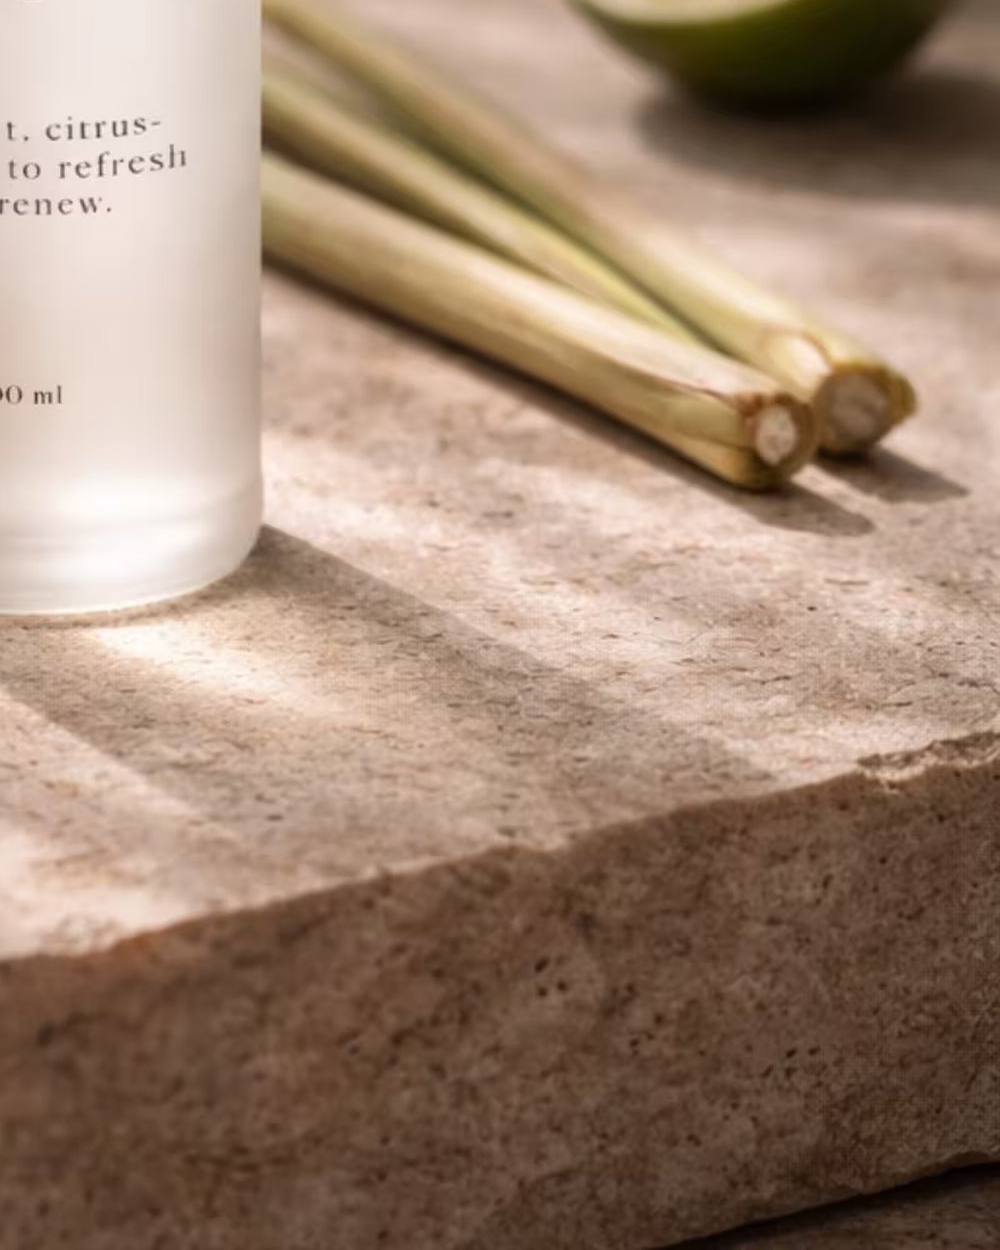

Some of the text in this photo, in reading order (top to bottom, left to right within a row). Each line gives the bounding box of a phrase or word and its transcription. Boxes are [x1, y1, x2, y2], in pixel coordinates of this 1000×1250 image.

[45, 116, 163, 142] citrus-
[8, 160, 42, 180] to
[58, 144, 187, 178] refresh
[33, 385, 63, 405] ml
